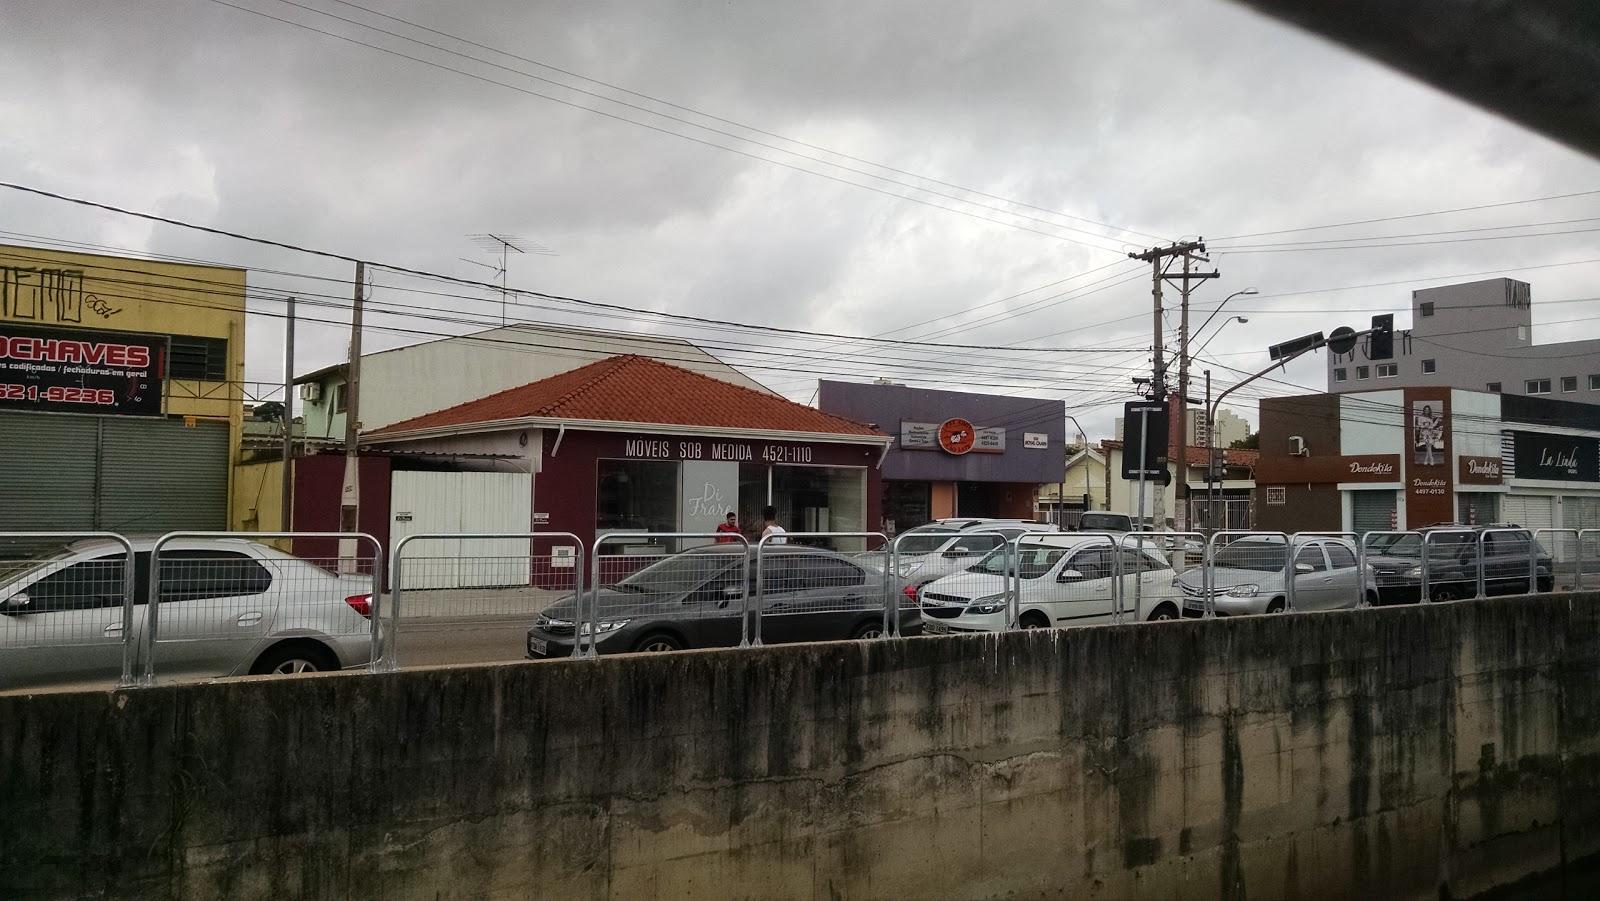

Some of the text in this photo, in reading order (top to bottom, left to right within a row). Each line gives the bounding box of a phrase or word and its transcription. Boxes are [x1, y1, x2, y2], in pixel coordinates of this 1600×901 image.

[63, 366, 110, 375] fechaduras
[625, 437, 812, 463] MÓVEIS SOB MEDIDA 4521-1110
[1540, 448, 1554, 466] La
[704, 482, 723, 502] Di
